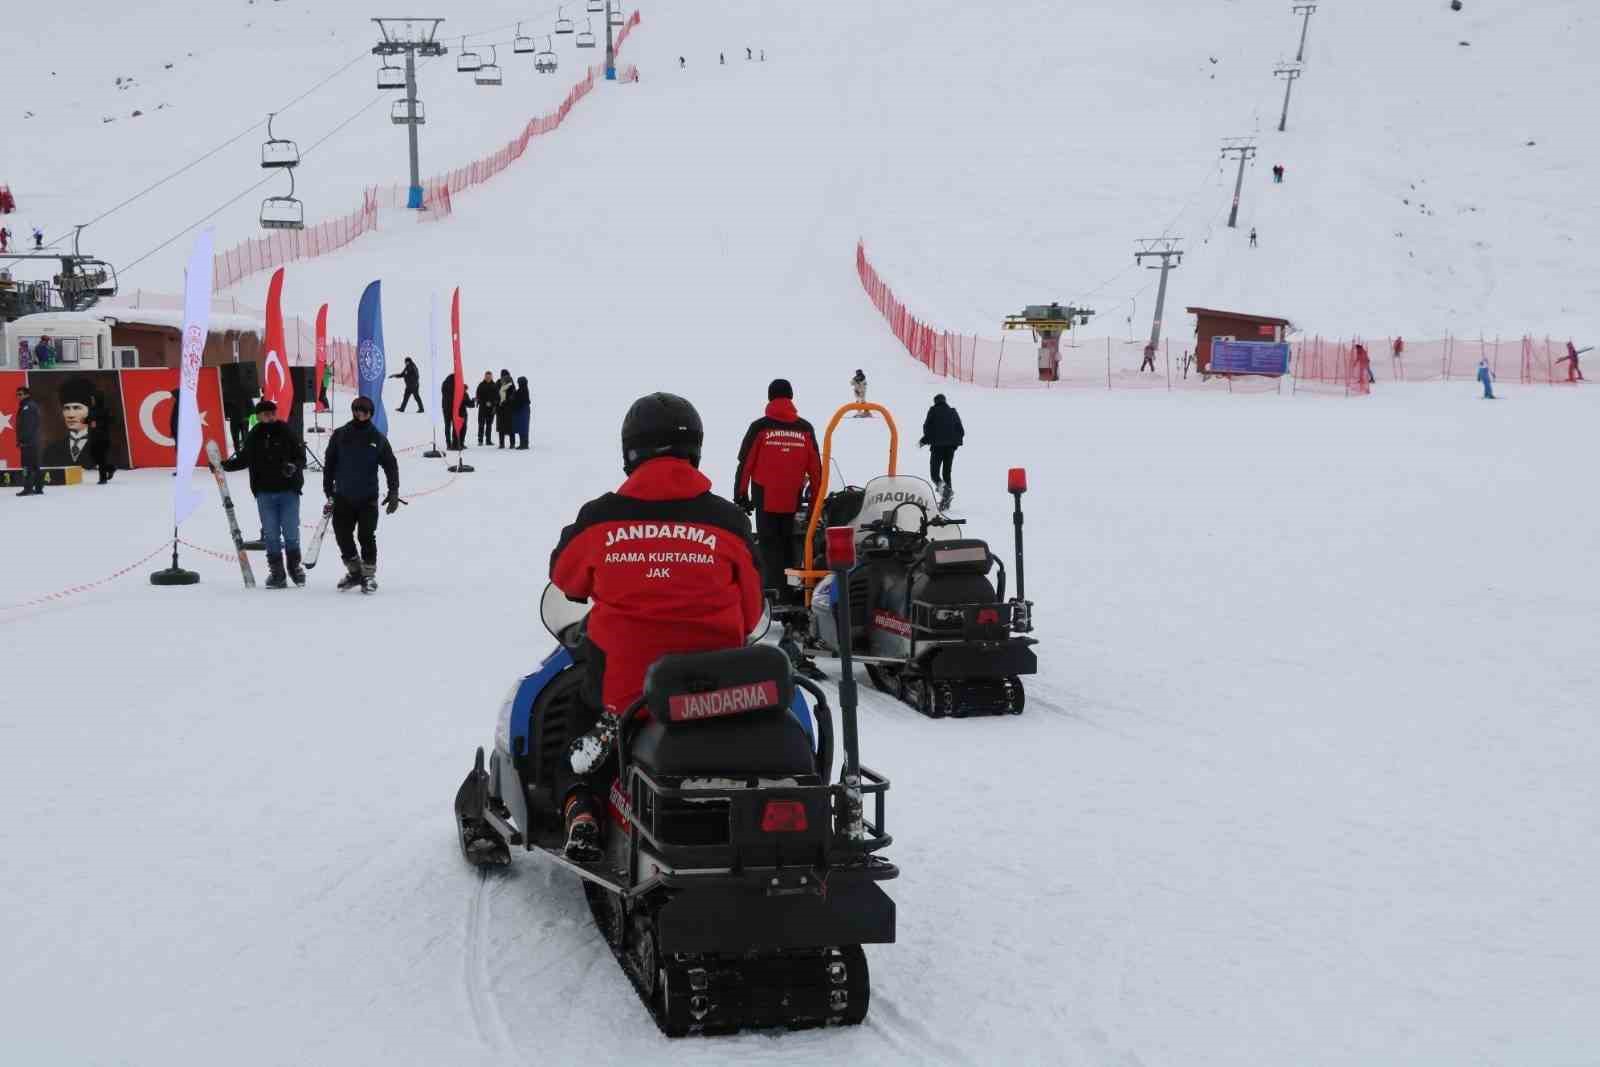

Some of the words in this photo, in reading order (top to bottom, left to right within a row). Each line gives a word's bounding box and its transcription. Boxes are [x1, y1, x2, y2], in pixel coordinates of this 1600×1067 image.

[605, 524, 717, 550] JANDARMA
[605, 552, 646, 563] ARAMA
[648, 552, 715, 564] KURTARMA
[646, 567, 671, 578] JAK
[681, 684, 769, 719] JANDARMA
